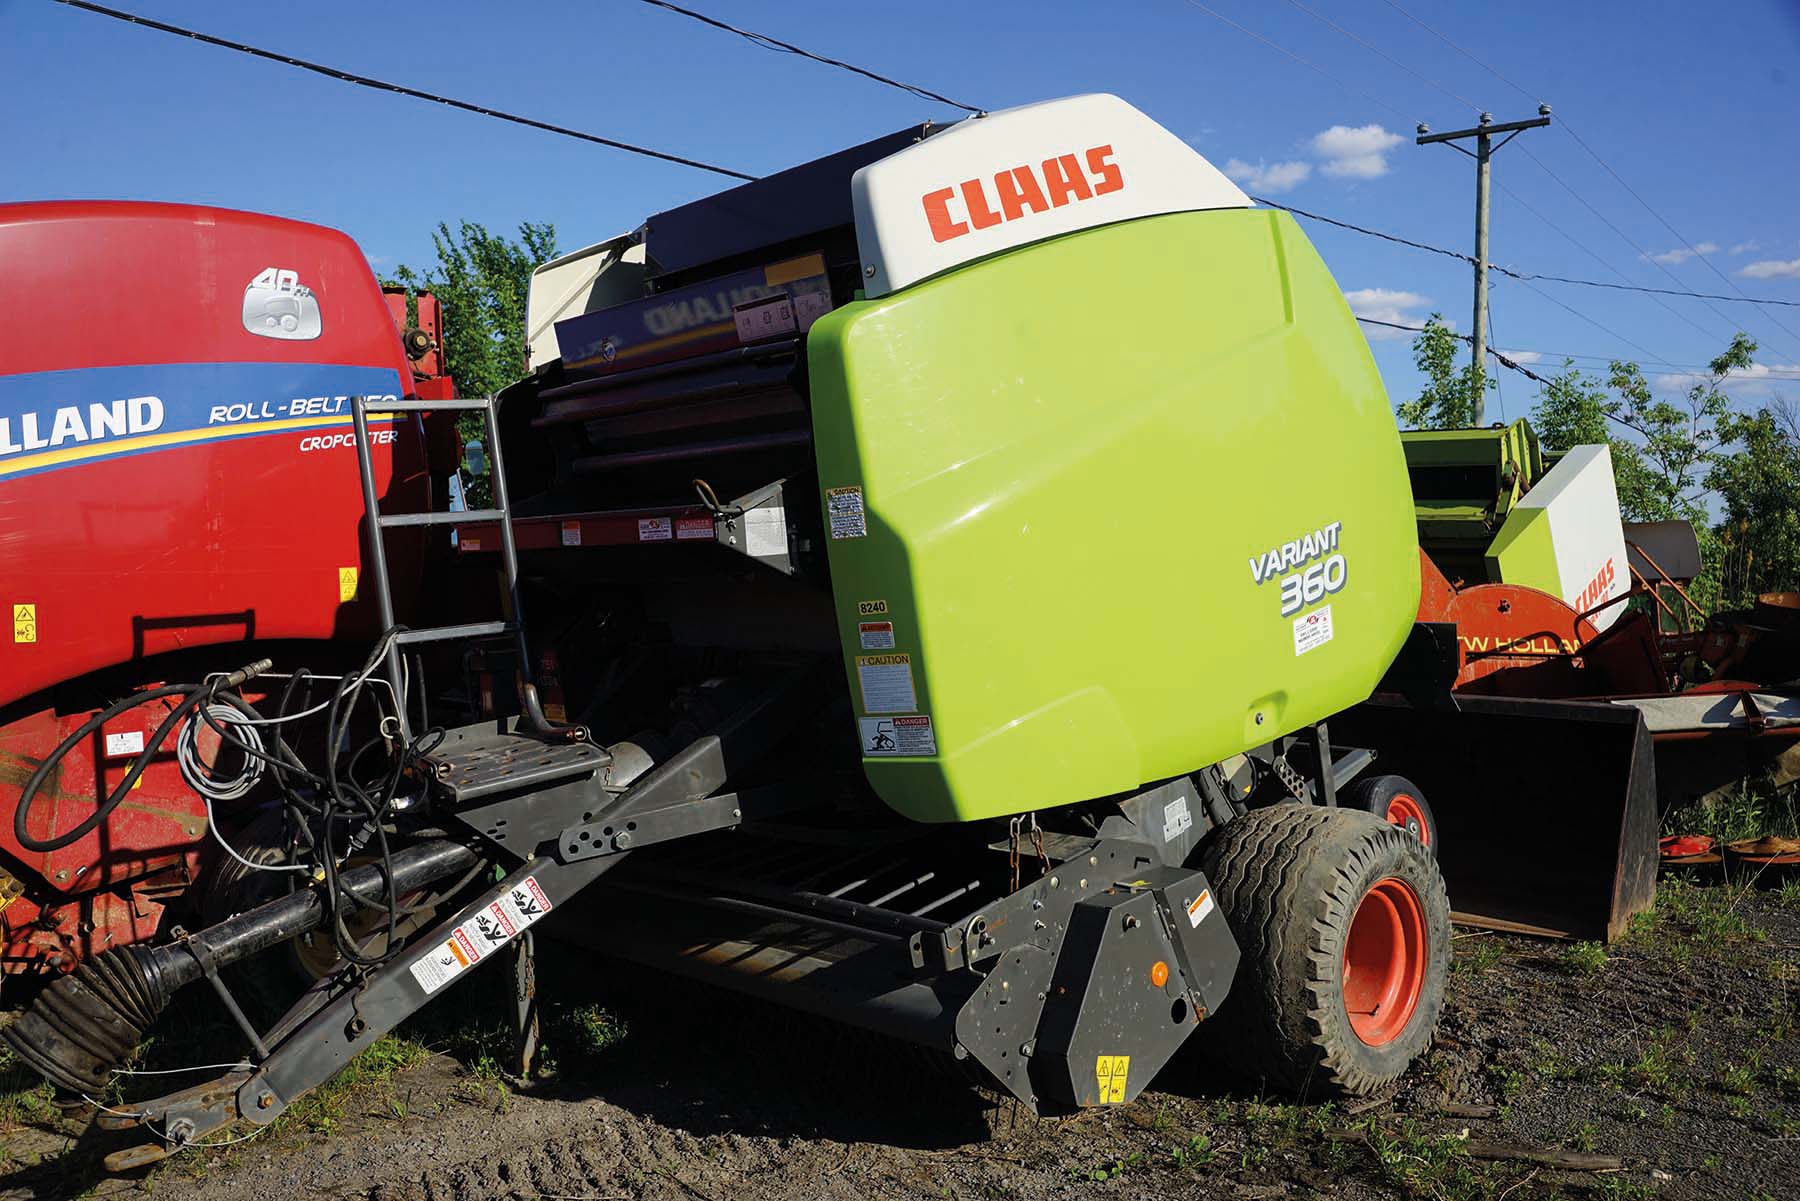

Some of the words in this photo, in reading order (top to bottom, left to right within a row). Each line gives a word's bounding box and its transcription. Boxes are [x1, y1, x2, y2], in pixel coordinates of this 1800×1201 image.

[922, 144, 1124, 243] CLAAS
[209, 396, 347, 424] ROLL-BELT
[300, 430, 398, 451] CROPCTER
[1249, 521, 1341, 585] VARIANT
[1281, 554, 1346, 617] 360
[1575, 557, 1615, 613] CLAAS
[860, 602, 885, 613] 8240
[868, 655, 909, 665] CAUTION
[901, 718, 928, 726] DANGER
[530, 885, 551, 912] DANGER
[495, 909, 516, 936] DANGER
[458, 935, 479, 962] DANGER
